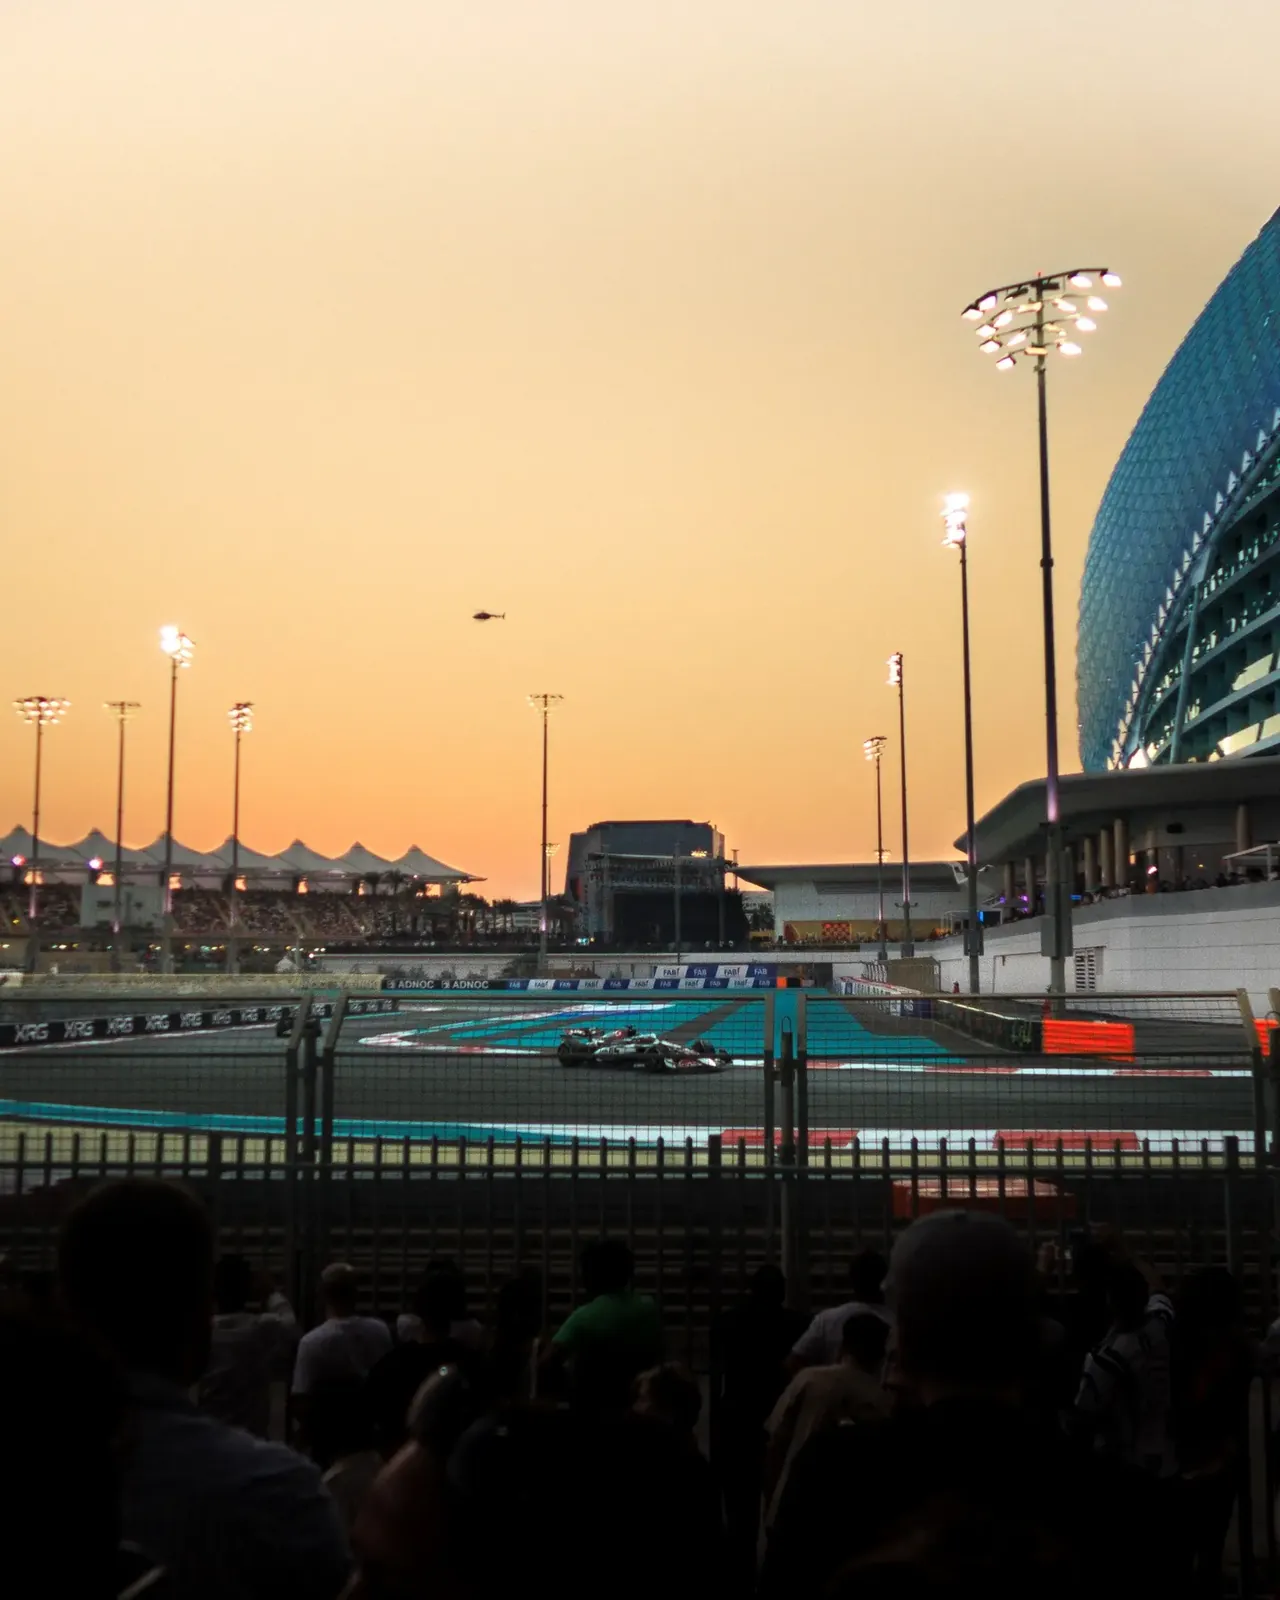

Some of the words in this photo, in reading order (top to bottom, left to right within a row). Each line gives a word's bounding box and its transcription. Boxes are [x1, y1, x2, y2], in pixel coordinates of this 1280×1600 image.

[693, 968, 707, 976] FAB
[753, 967, 767, 976] FAB
[398, 980, 435, 989] ADNOC
[452, 980, 489, 989] ADNOC
[63, 1020, 94, 1039] XRG
[107, 1016, 134, 1034] XRG
[14, 1022, 49, 1043] XRG
